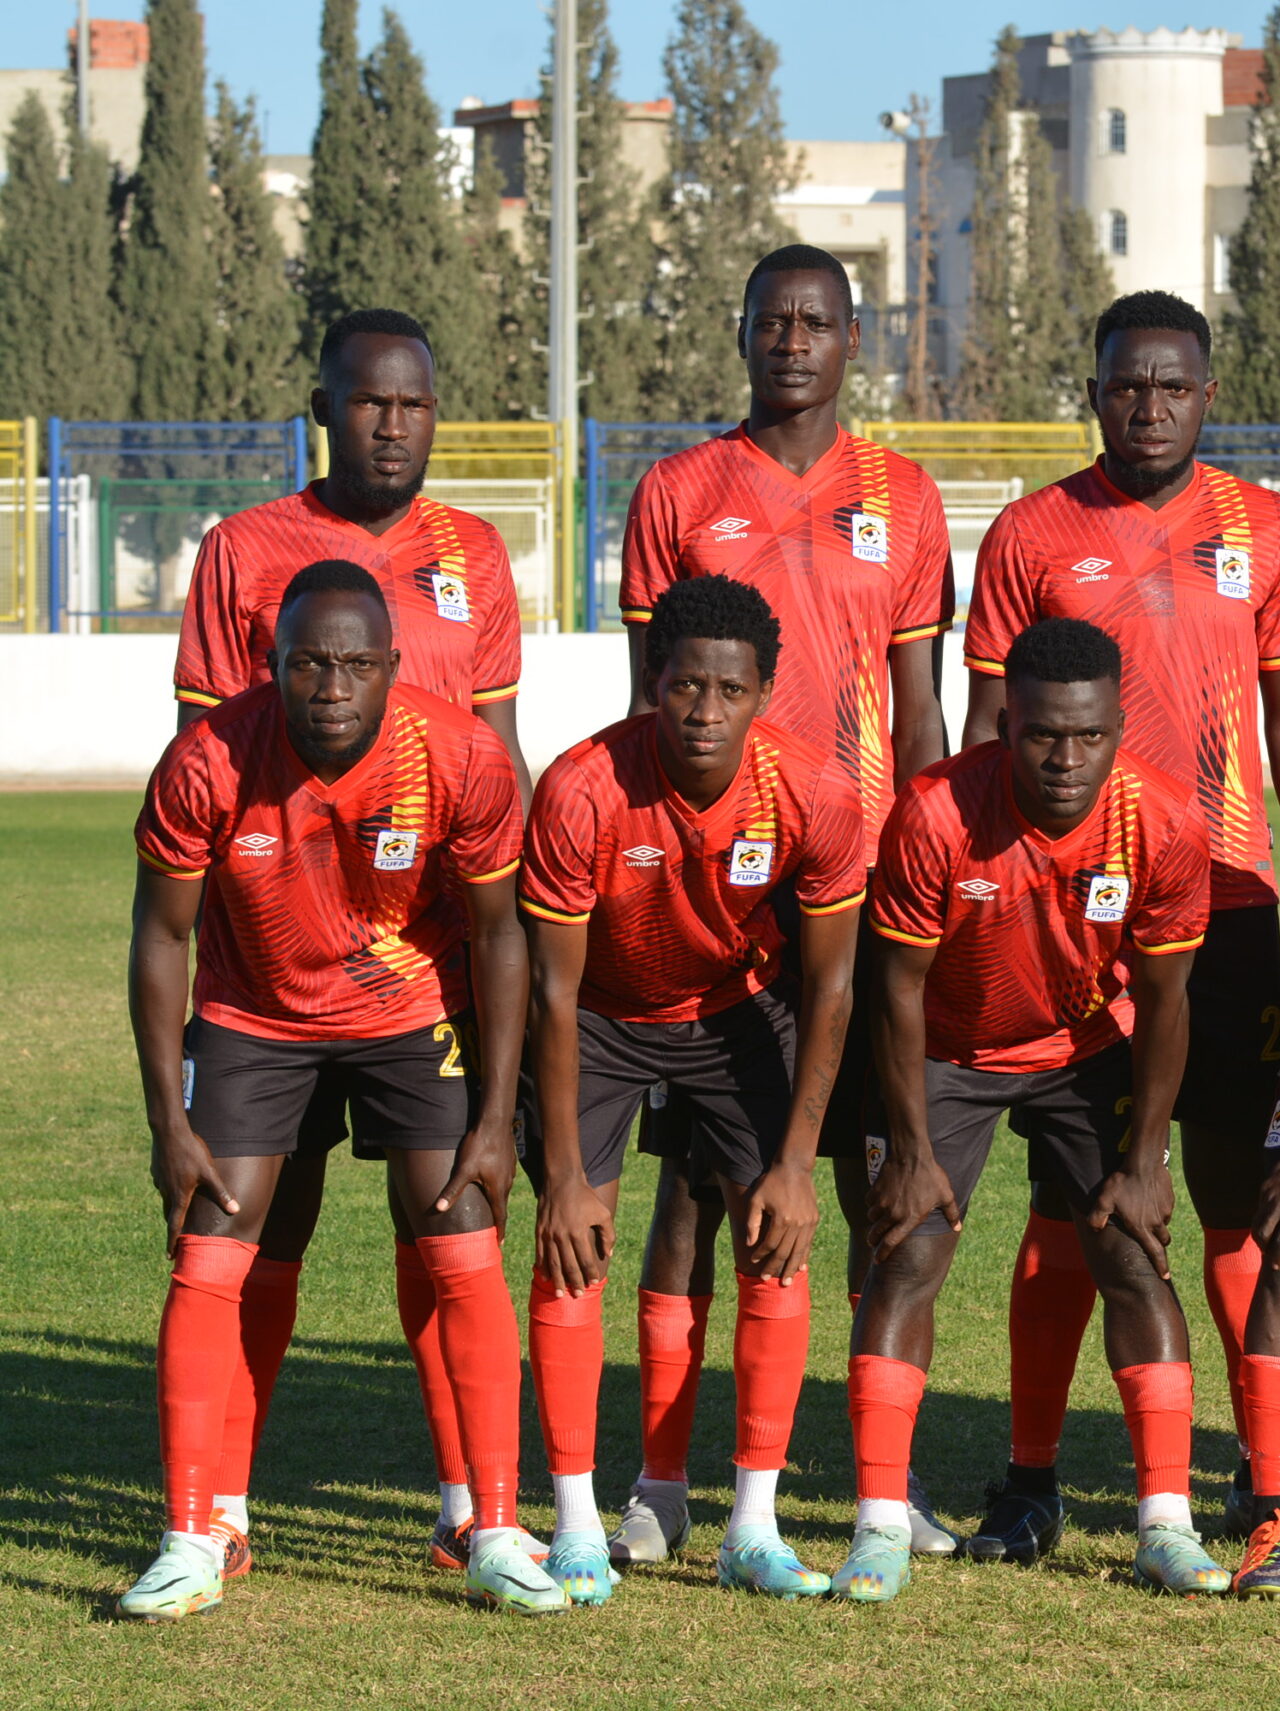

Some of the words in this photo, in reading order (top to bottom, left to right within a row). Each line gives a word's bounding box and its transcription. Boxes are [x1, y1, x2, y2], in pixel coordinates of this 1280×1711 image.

[715, 532, 748, 541] umbro
[859, 548, 881, 558] FUFA
[1076, 574, 1109, 584] umbro
[1222, 585, 1244, 594] FUFA
[443, 607, 464, 617] FUFA
[1091, 911, 1116, 919] FUFA
